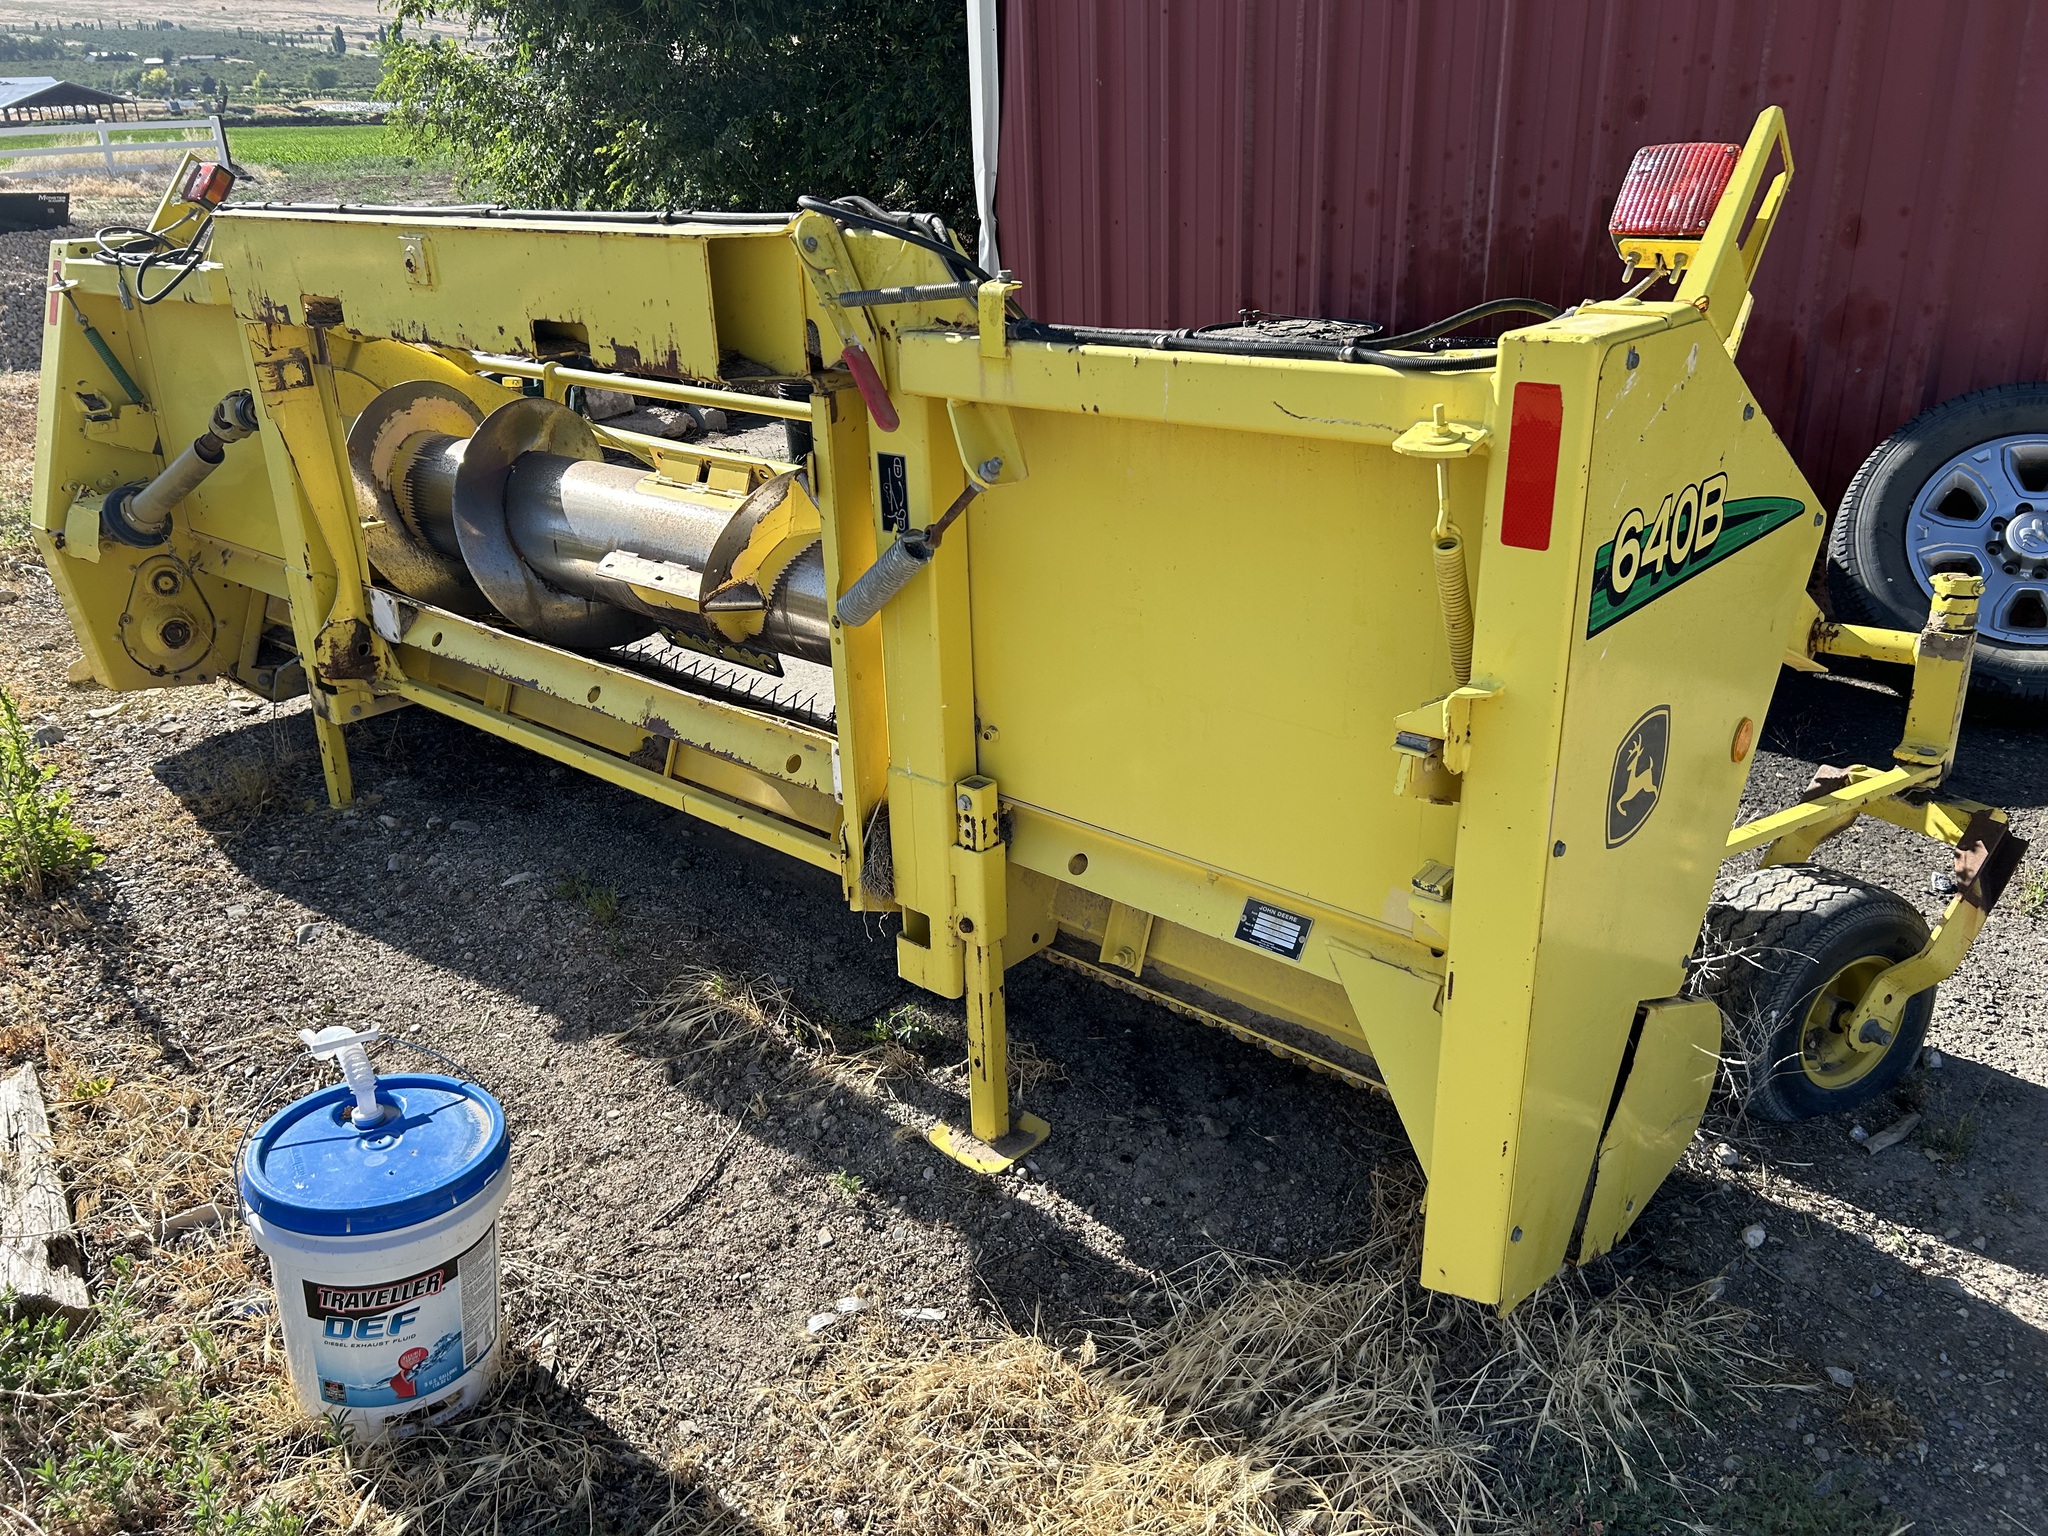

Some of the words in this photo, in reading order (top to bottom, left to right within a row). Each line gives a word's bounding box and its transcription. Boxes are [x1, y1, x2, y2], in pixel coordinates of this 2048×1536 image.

[1608, 471, 1728, 600] 640B
[1259, 905, 1277, 916] JOHN
[1276, 911, 1298, 923] DEERE
[319, 1271, 443, 1312] TRAVELLER
[323, 1306, 421, 1340] DEF
[392, 1333, 417, 1344] FLUID
